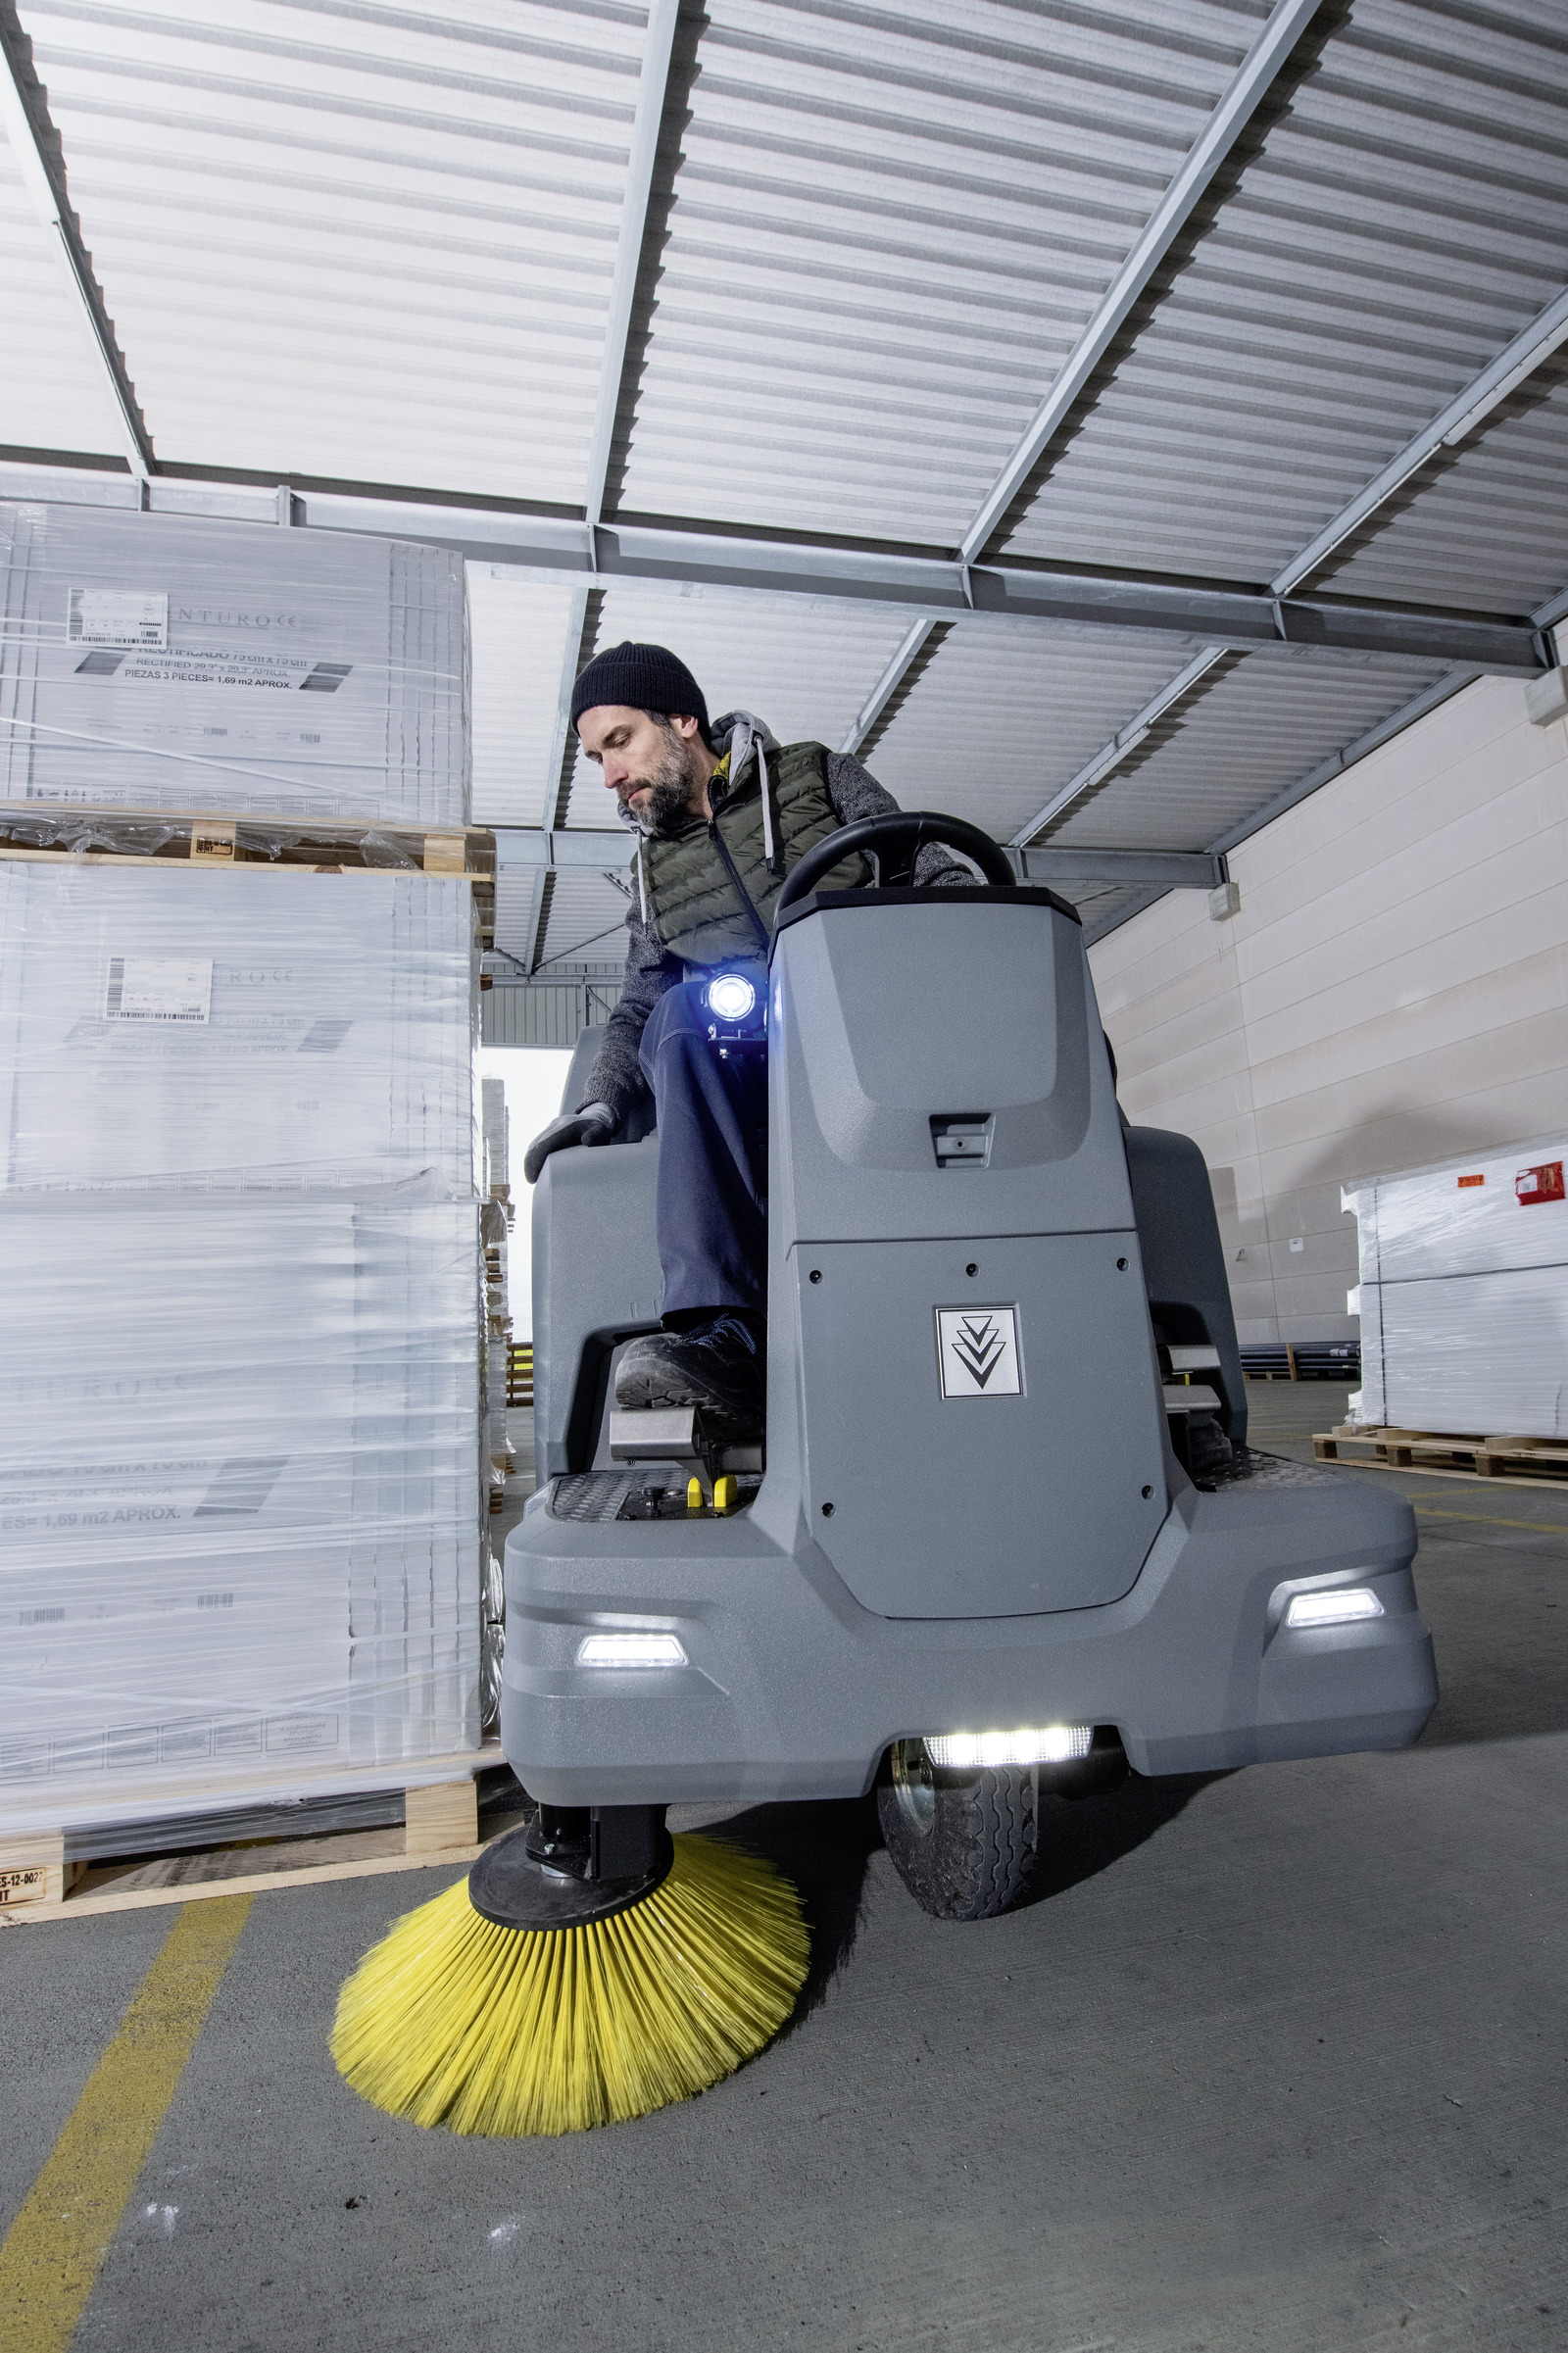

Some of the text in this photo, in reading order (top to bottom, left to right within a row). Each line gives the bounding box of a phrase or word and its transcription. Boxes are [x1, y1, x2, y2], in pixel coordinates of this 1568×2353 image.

[136, 658, 191, 669] RECTIFIED
[252, 667, 291, 678] APROX.
[124, 669, 161, 679] PIEZAS
[172, 672, 215, 683] PIECES=
[217, 675, 236, 685] 1,69
[238, 678, 253, 687] m2
[254, 679, 293, 689] APROX.
[43, 1512, 78, 1529] 1,69
[82, 1510, 109, 1526] m2
[113, 1505, 181, 1523] APROX.
